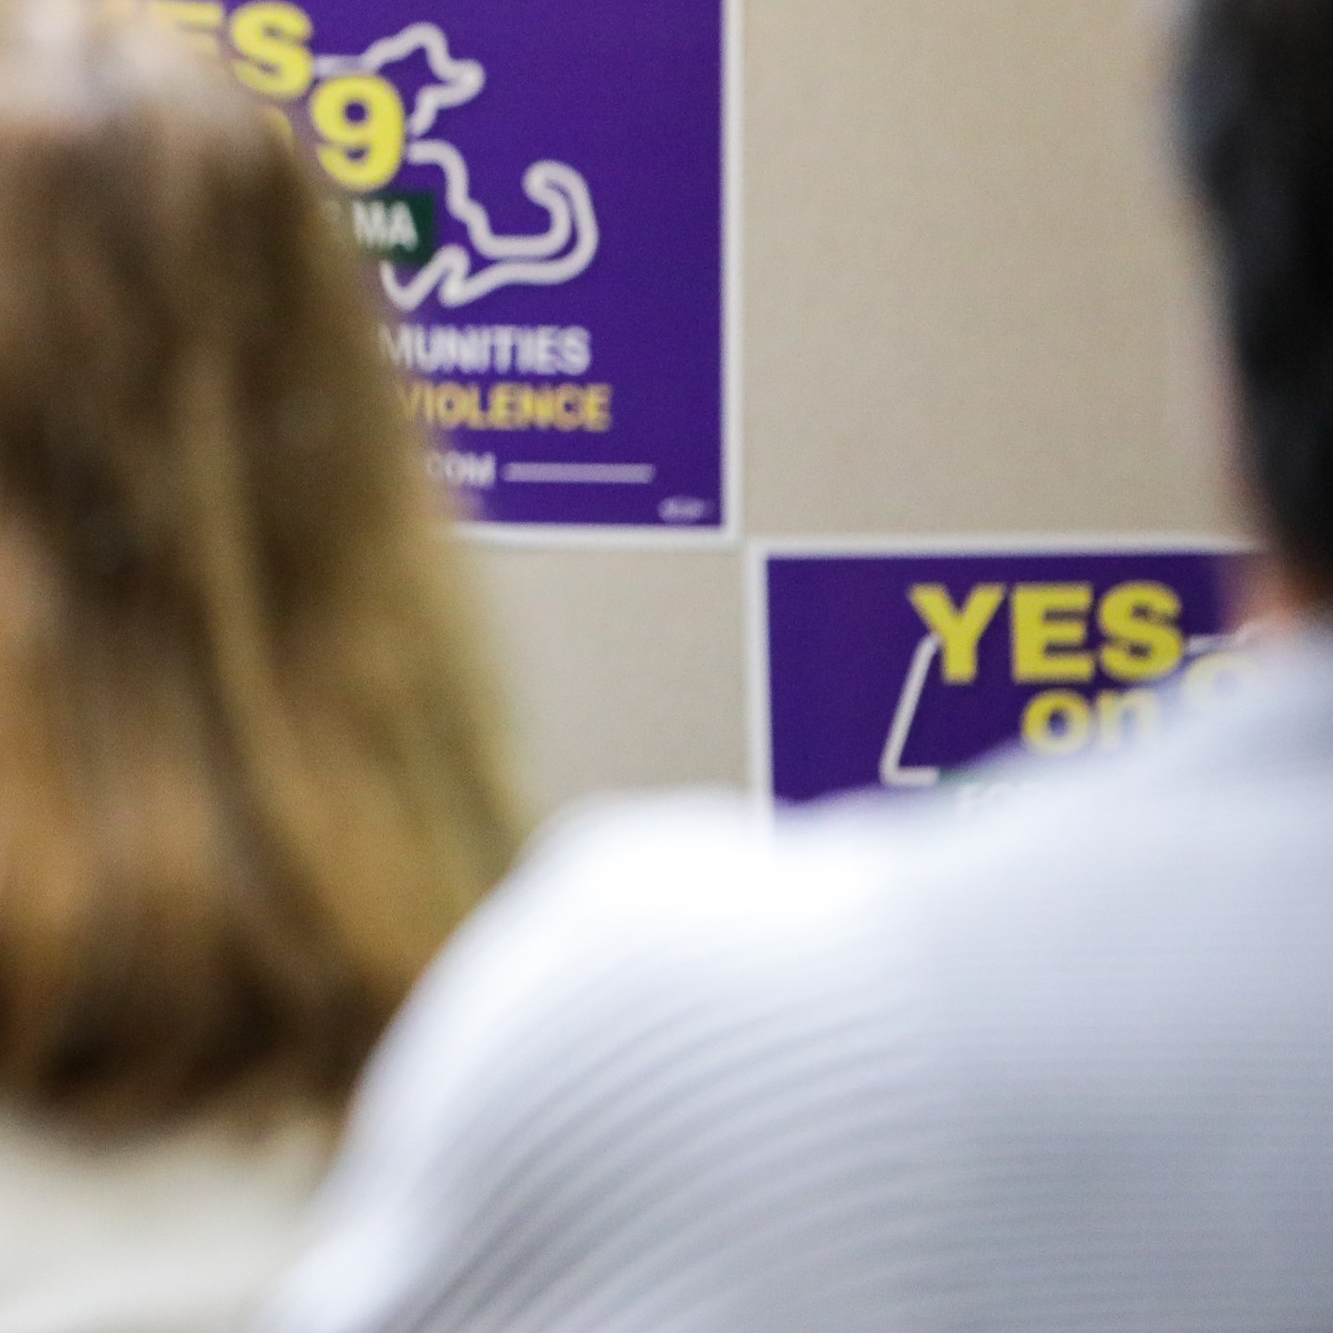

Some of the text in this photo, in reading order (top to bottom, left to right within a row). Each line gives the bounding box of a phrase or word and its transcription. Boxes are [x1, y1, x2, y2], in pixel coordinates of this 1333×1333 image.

[310, 73, 407, 189] 9
[909, 581, 1184, 684] YES
[1021, 689, 1161, 753] on
